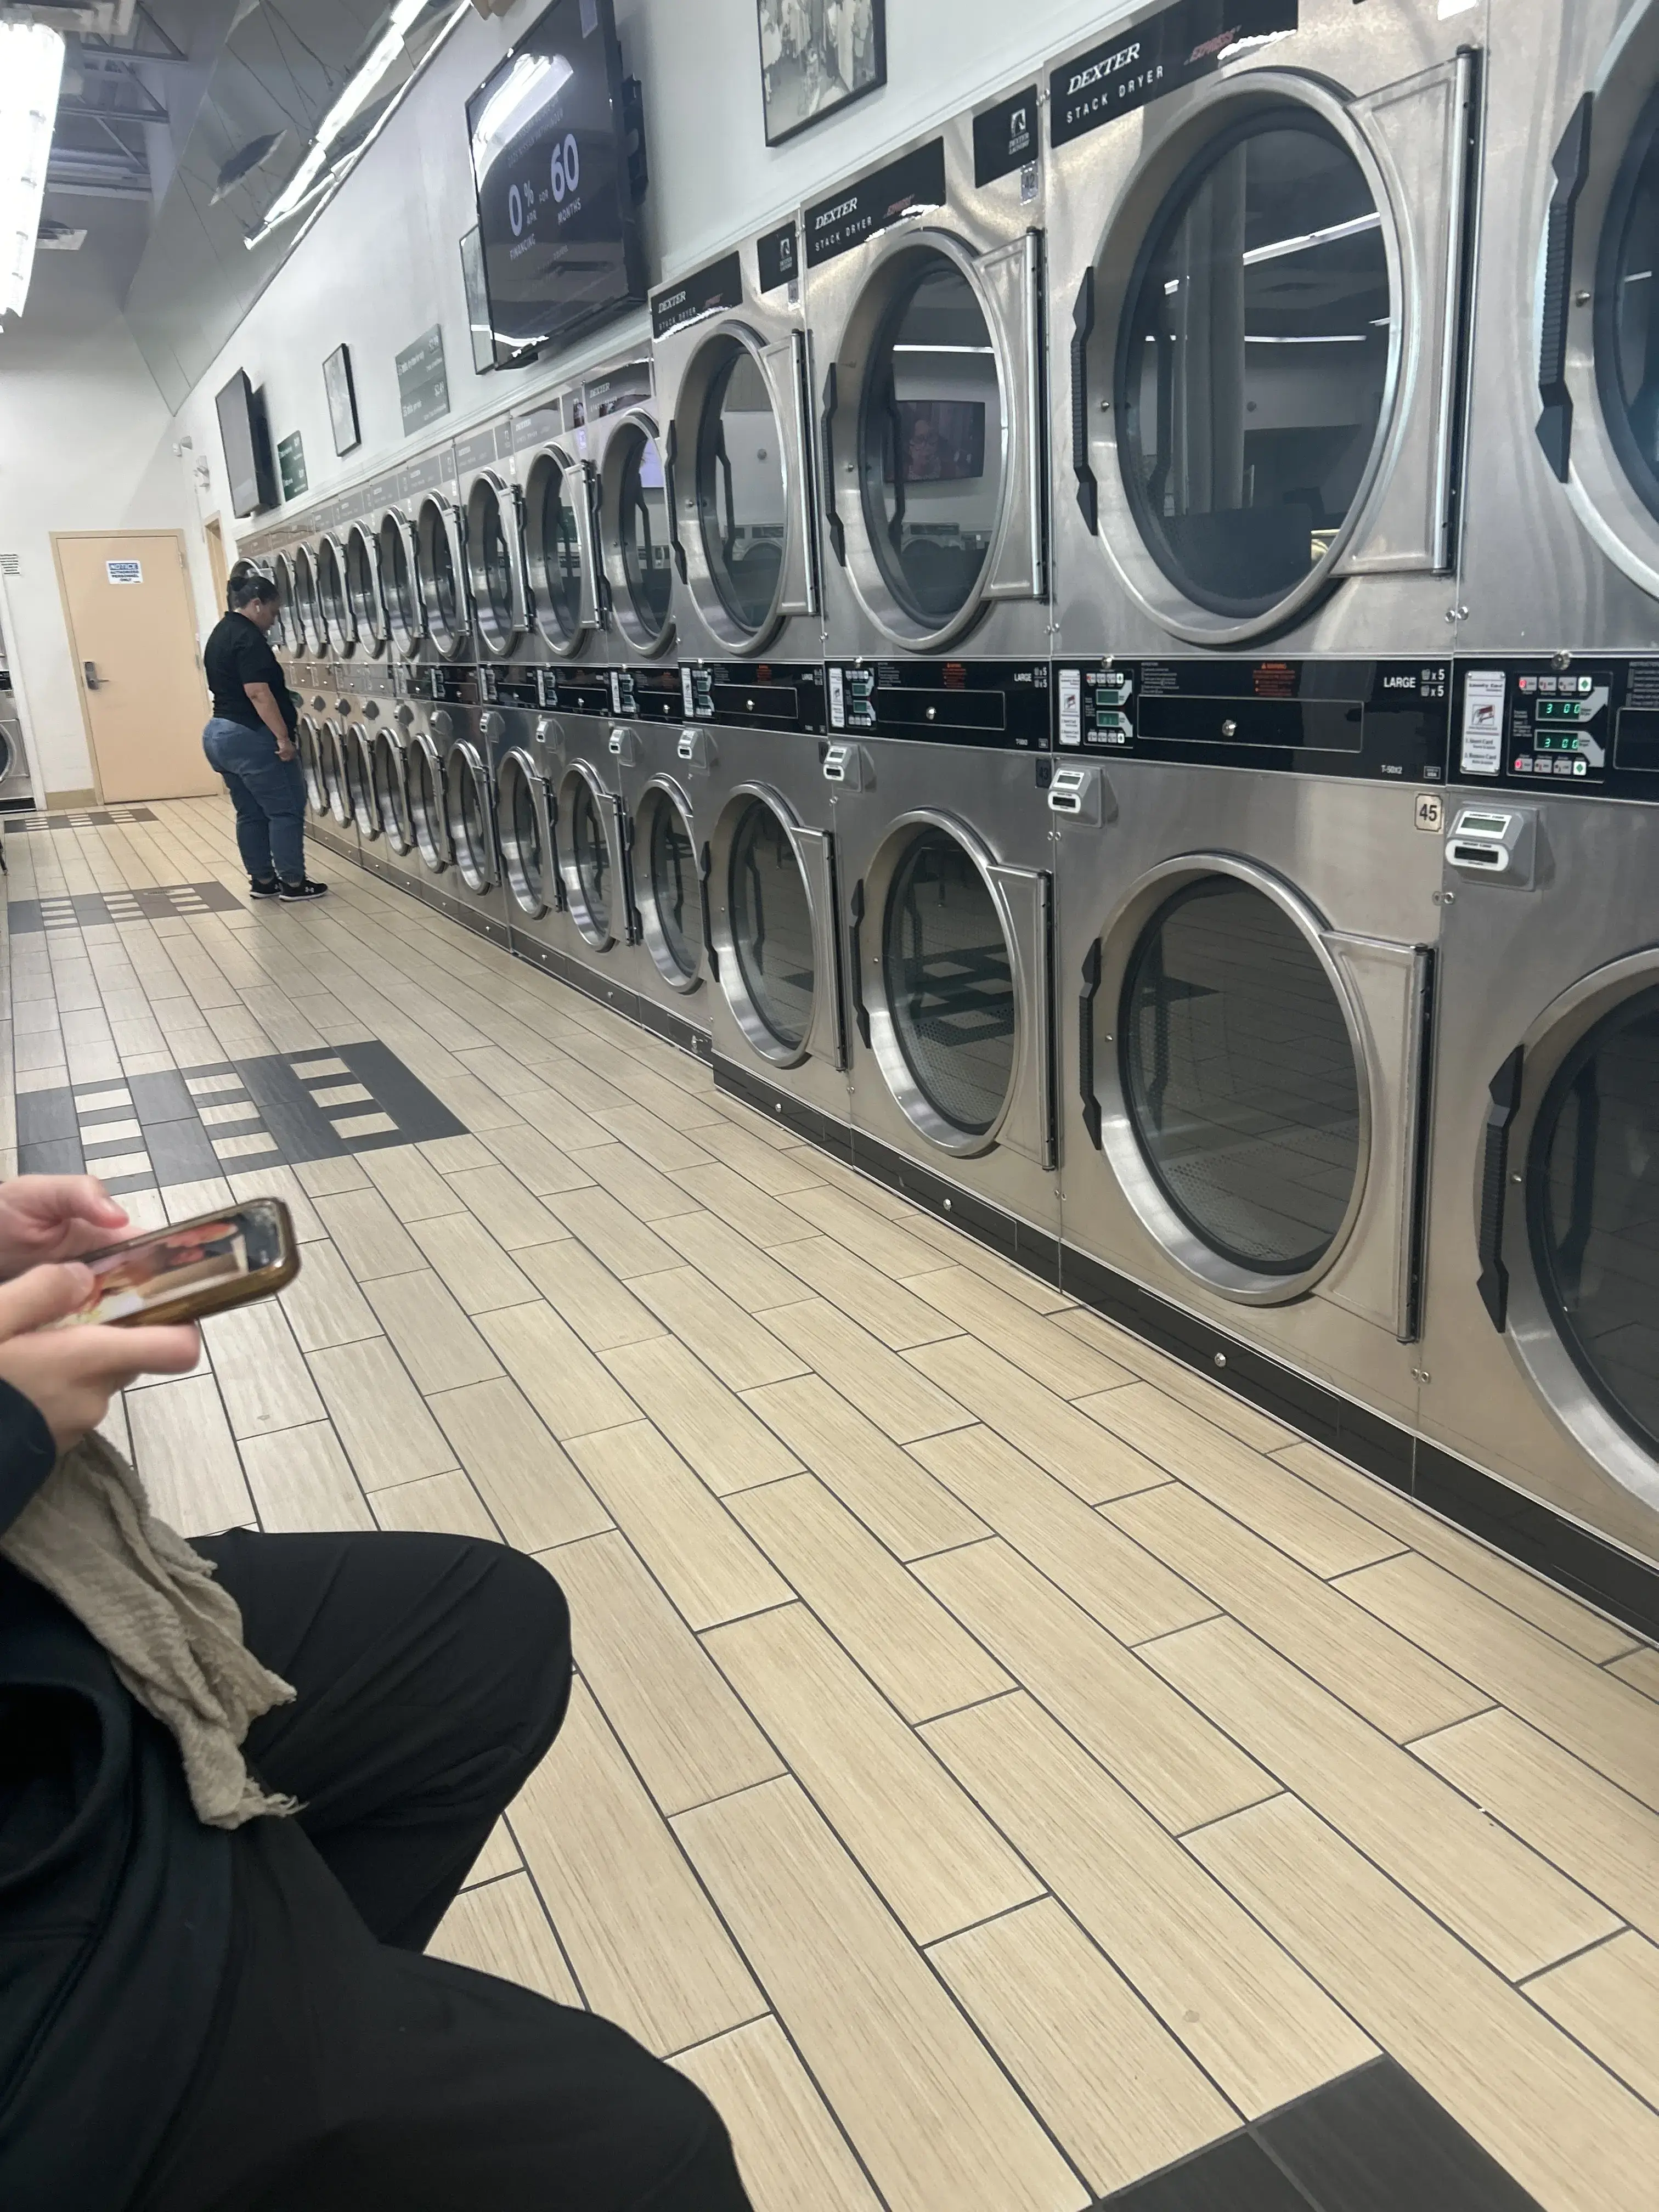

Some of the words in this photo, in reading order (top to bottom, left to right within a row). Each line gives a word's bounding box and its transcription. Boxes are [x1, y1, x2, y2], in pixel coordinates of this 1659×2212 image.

[1066, 42, 1141, 95] DEXTER
[1066, 92, 1109, 124] STACK
[1118, 65, 1164, 98] DRYER
[551, 133, 579, 203] 60
[526, 210, 538, 227] APR
[557, 197, 582, 225] MONTHS
[815, 197, 858, 230] DEXTER
[509, 233, 536, 261] FINANCING
[815, 231, 841, 252] STACK
[845, 216, 872, 237] DRYER
[658, 291, 686, 314] DEXTER
[589, 382, 611, 398] DEXTER
[1013, 673, 1032, 682] LARGE
[1383, 676, 1416, 689] LARGE
[1419, 803, 1438, 822] 45
